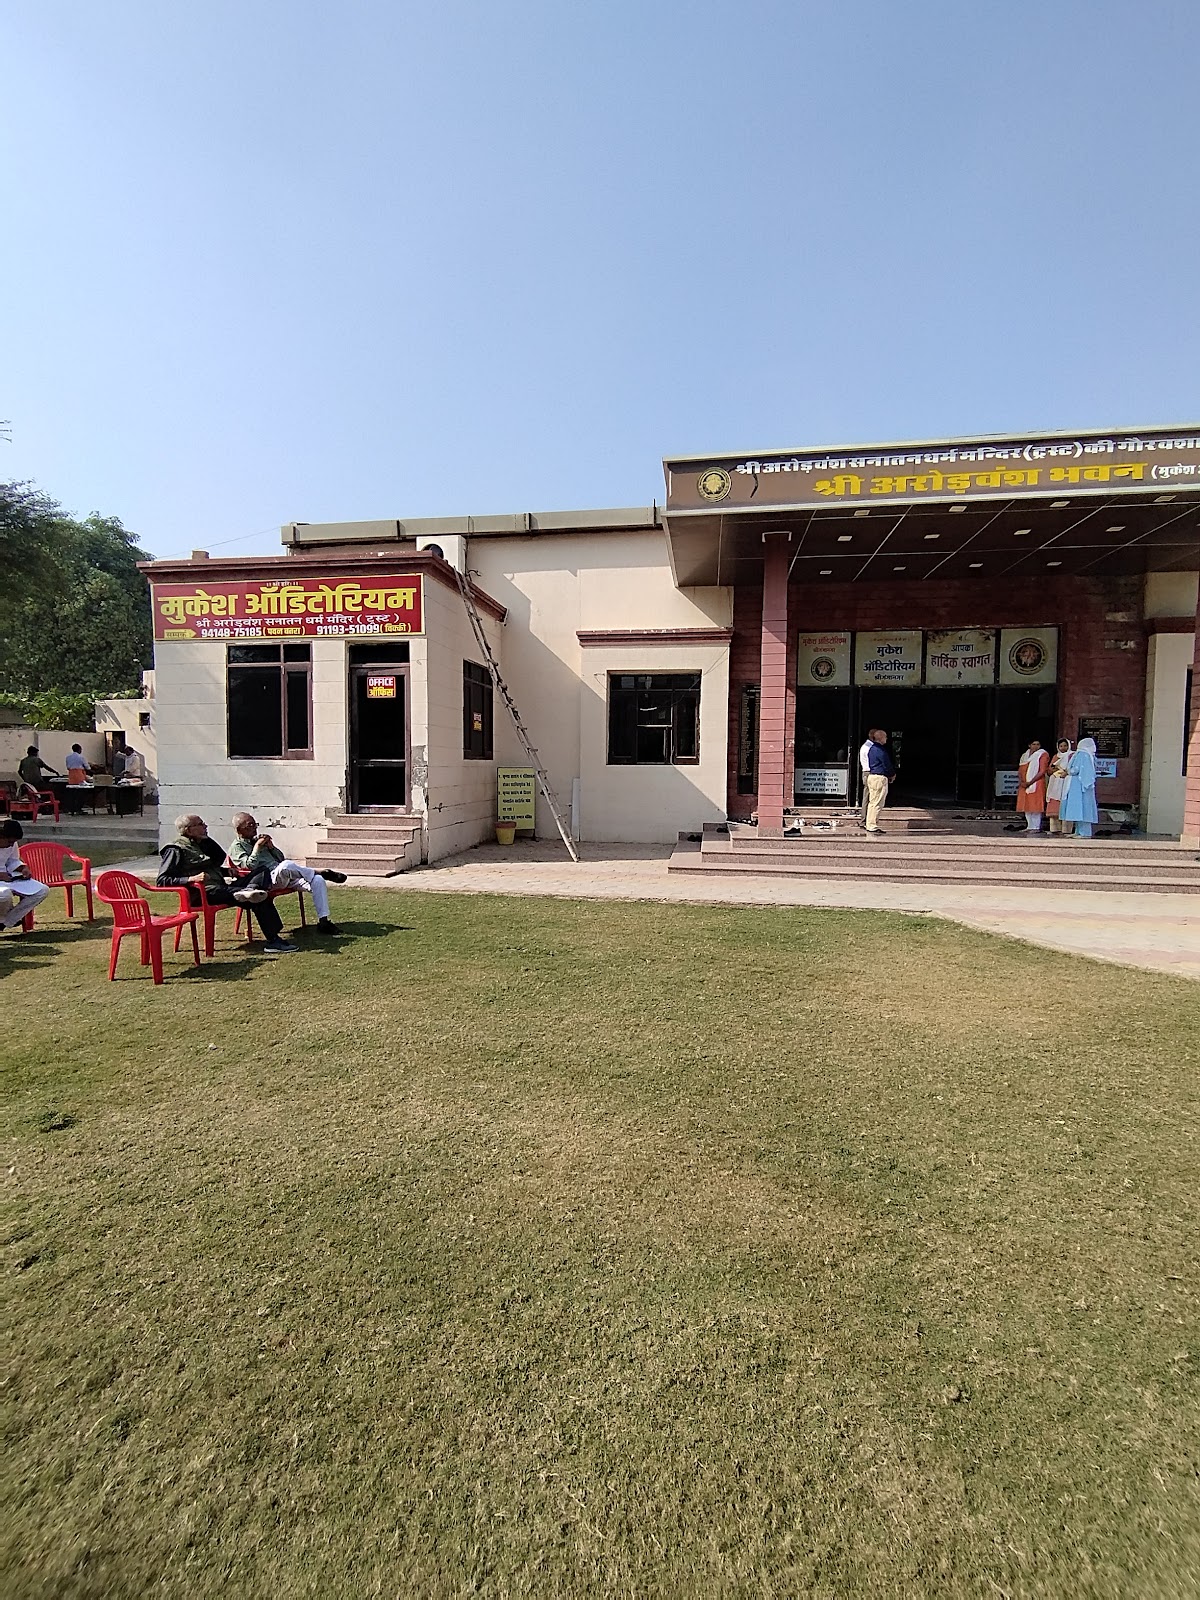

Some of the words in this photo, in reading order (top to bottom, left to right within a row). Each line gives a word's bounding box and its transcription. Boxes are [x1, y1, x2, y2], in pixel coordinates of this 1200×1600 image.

[735, 461, 762, 475] श्री
[849, 451, 921, 468] सनातन
[923, 448, 959, 464] धर्म
[1084, 439, 1116, 454] की
[813, 474, 865, 496] श्री
[1049, 462, 1148, 484] भवन
[157, 589, 239, 625] मुकेश
[245, 583, 417, 615] ऑडिटोरियम
[196, 617, 211, 628] श्री
[264, 616, 303, 626] सनातन
[305, 614, 324, 625] धर्म
[326, 613, 355, 625] मंदिर
[201, 627, 262, 638] 94148-75185
[316, 623, 380, 635] 91193-51099
[876, 643, 903, 657] मुकेश
[863, 660, 916, 673] ऑडिटोरियम
[930, 650, 958, 670] हार्दिक
[961, 653, 991, 669] स्वागत
[368, 678, 394, 687] OFFICE
